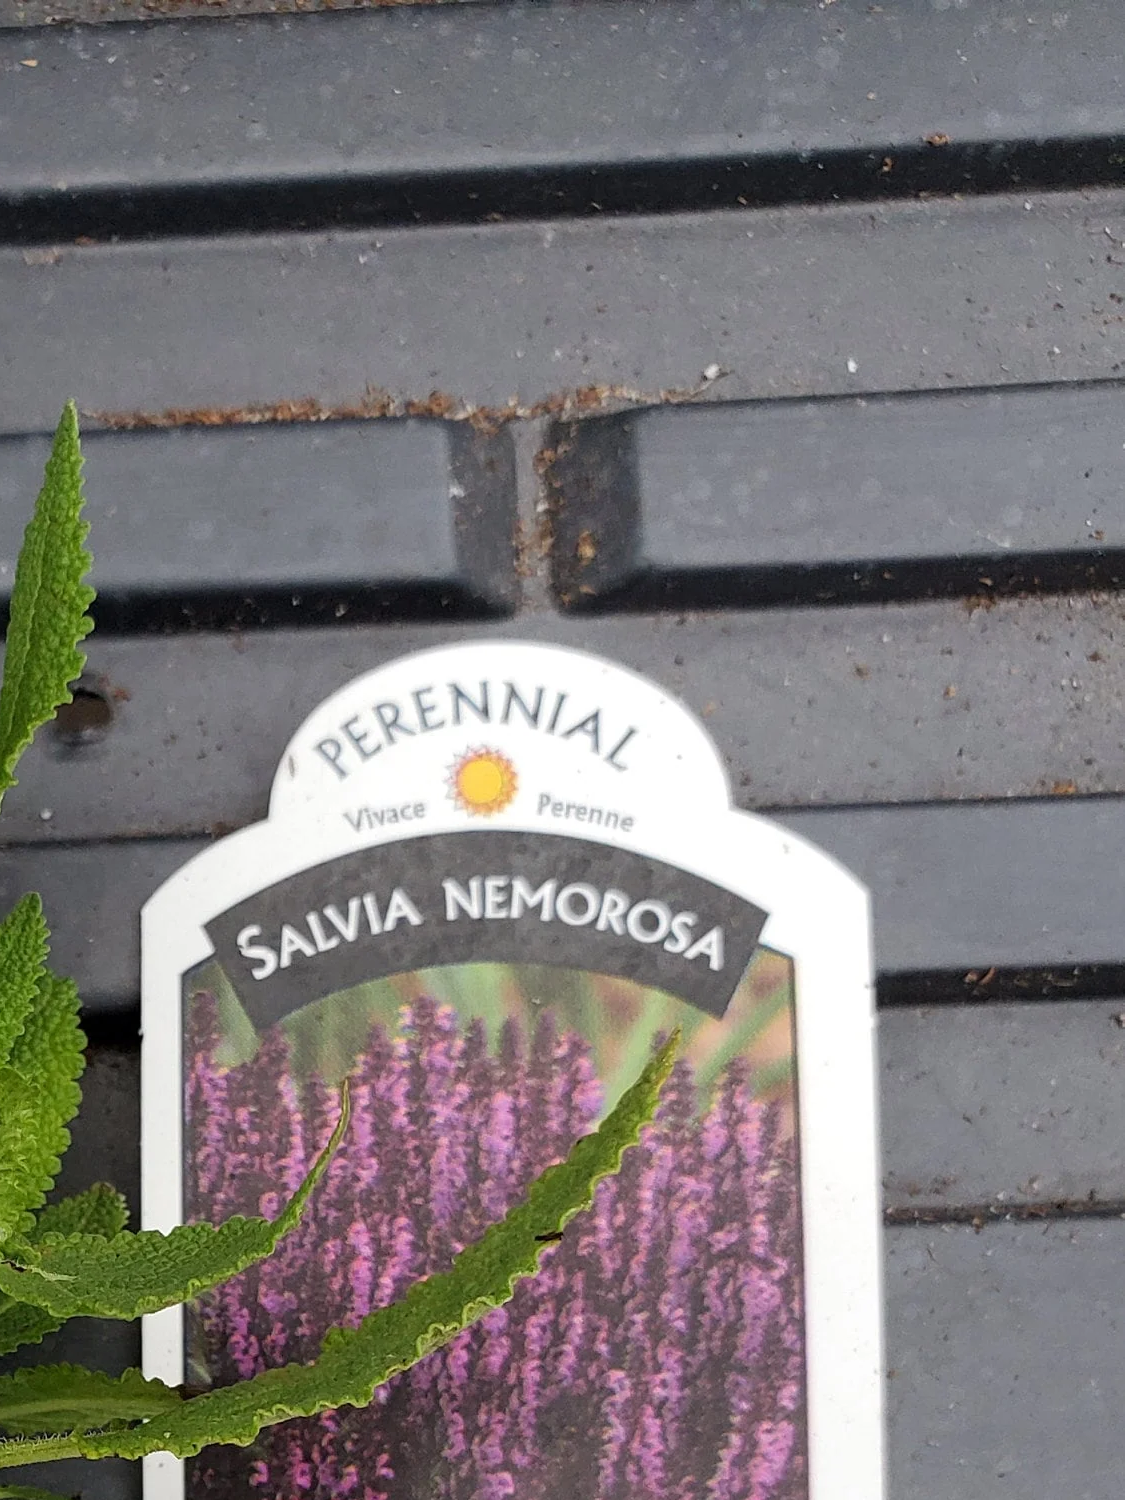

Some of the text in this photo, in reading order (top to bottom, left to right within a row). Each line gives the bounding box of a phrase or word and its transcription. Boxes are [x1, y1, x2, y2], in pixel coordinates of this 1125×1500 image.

[313, 678, 642, 781] PERENNIAL
[343, 792, 635, 834] Vivace Perenne
[235, 876, 727, 981] SALVIA NEMOROSA
